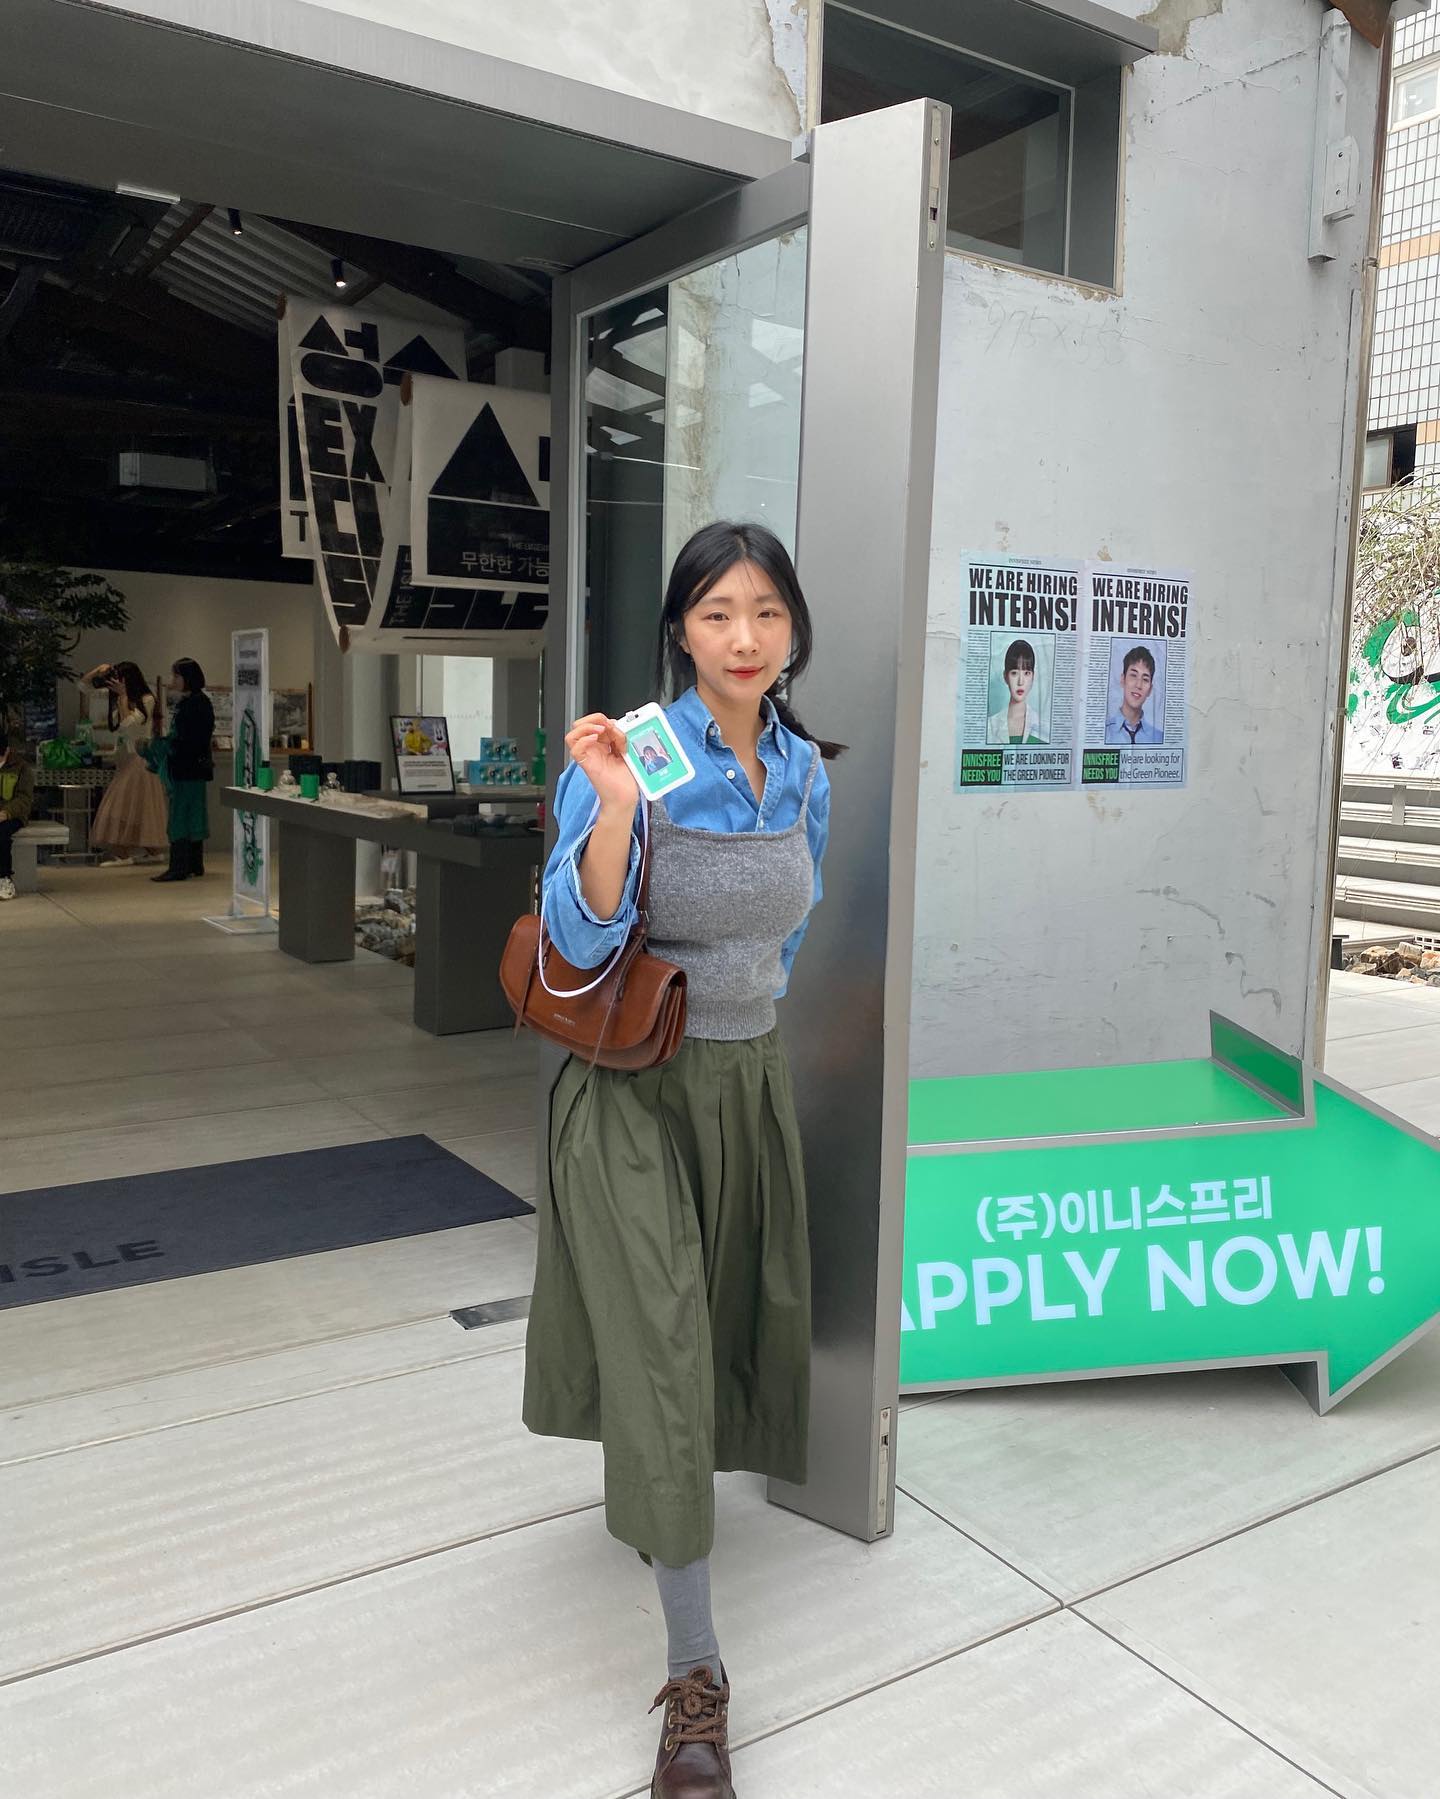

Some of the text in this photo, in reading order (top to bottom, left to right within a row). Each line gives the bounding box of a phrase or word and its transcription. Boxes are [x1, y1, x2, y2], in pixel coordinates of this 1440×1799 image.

[460, 551, 512, 574] 무한한
[969, 568, 1078, 596] WE ARE HIRING
[1092, 577, 1189, 605] WE ARE HIRING
[969, 591, 1077, 632] INTERNS!
[1092, 599, 1187, 638] INTERNS!
[963, 753, 1002, 767] INNISFREE
[1003, 753, 1070, 765] WE ARE LOOKING FOR
[1084, 753, 1119, 766] INNISFREE
[1120, 752, 1132, 764] We
[1144, 752, 1170, 767] looking
[1171, 752, 1181, 764] for
[962, 769, 1001, 782] NEEDS YOU
[1003, 769, 1016, 781] THE
[1017, 769, 1038, 781] GREEN
[1082, 767, 1118, 780] NEEDS YOU
[1120, 768, 1132, 779] the
[1132, 768, 1153, 779] Green
[976, 1175, 1273, 1243] (주)이니스프리
[901, 1225, 1386, 1332] PPLY NOW!
